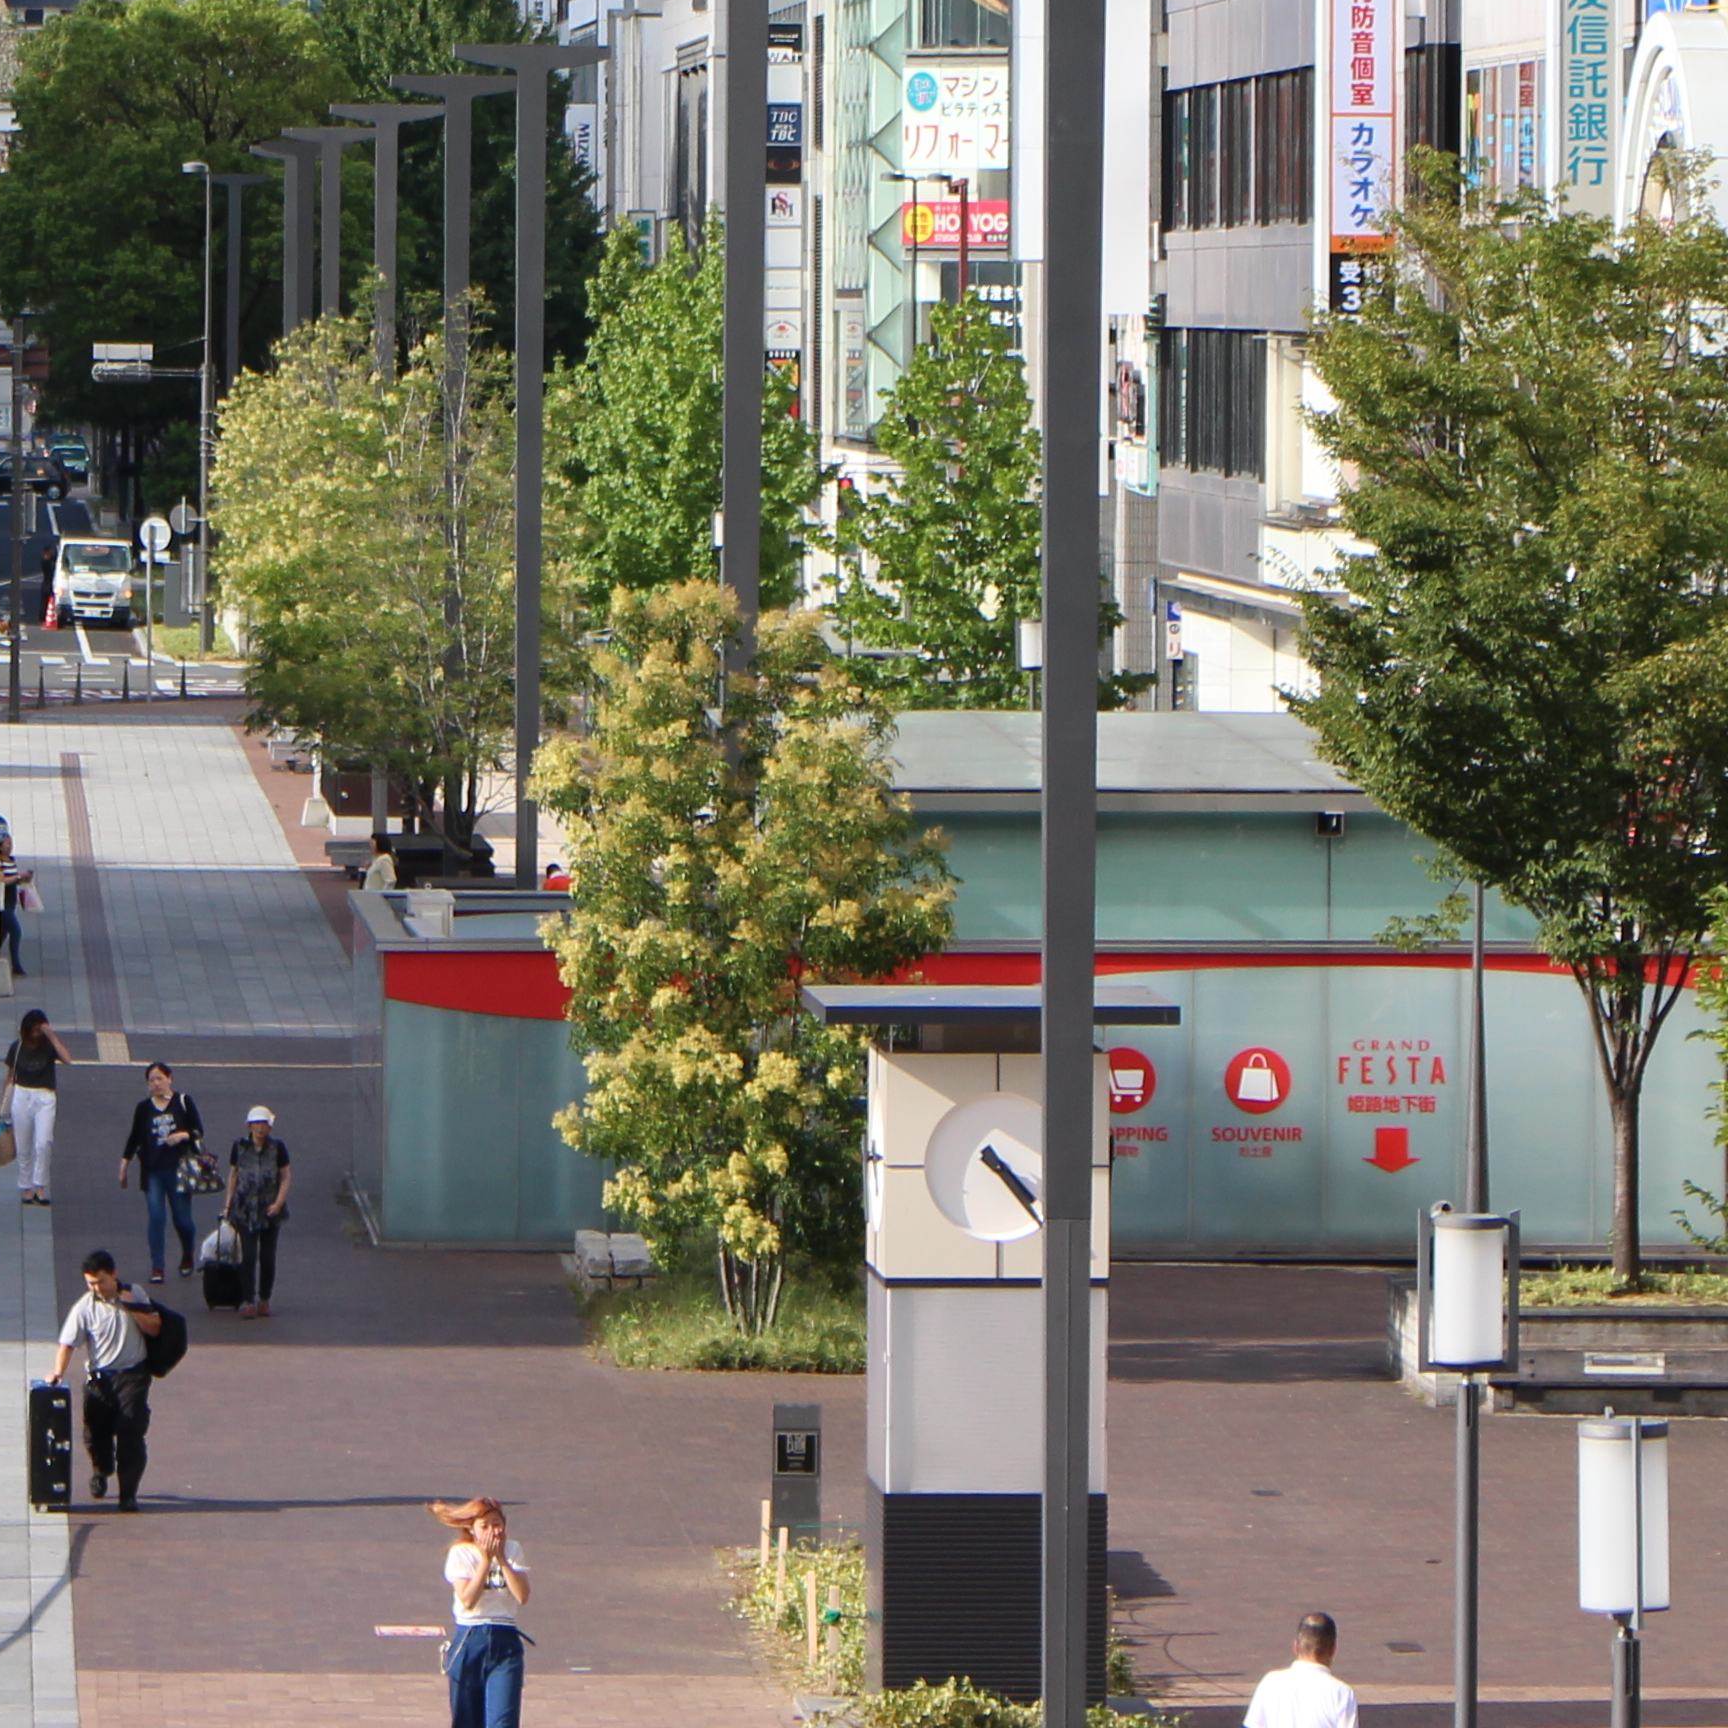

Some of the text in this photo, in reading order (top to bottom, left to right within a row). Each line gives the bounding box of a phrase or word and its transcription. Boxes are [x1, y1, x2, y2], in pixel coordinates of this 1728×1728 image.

[942, 102, 1002, 117] ピラティス
[1350, 122, 1376, 229] カラオケ
[934, 213, 962, 232] HO
[969, 213, 1010, 232] YOG
[1352, 1039, 1432, 1051] GRAND
[1337, 1056, 1447, 1085] FESTA
[1347, 1095, 1437, 1114] 姫路地下街
[1211, 1127, 1303, 1143] SOUVENIR
